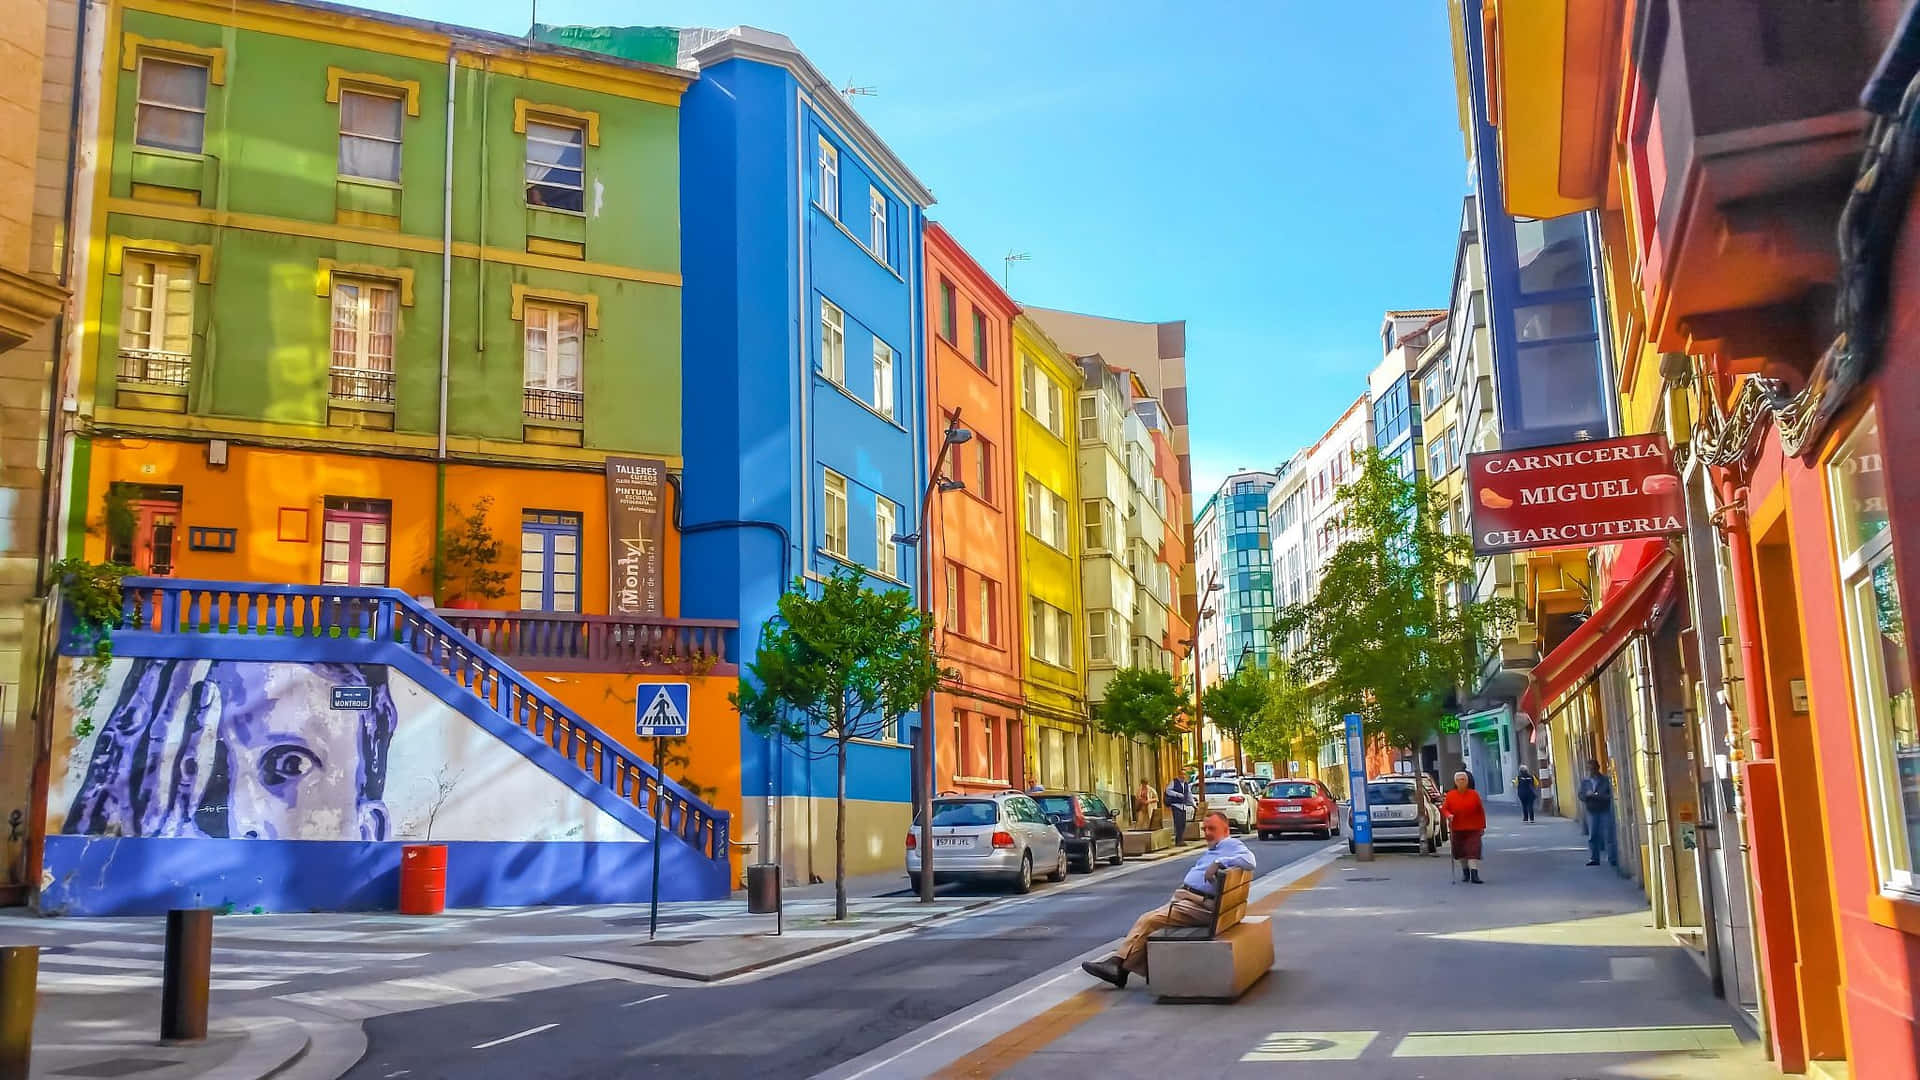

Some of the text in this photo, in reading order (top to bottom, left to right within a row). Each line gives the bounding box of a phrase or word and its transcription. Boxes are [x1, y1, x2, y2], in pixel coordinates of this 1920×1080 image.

[615, 464, 657, 475] TALLERES
[1485, 443, 1664, 474] CARNICERIA
[615, 487, 654, 497] PINTURA
[1520, 478, 1638, 506] MIGUEL
[1483, 516, 1683, 546] CHARCUTERIA
